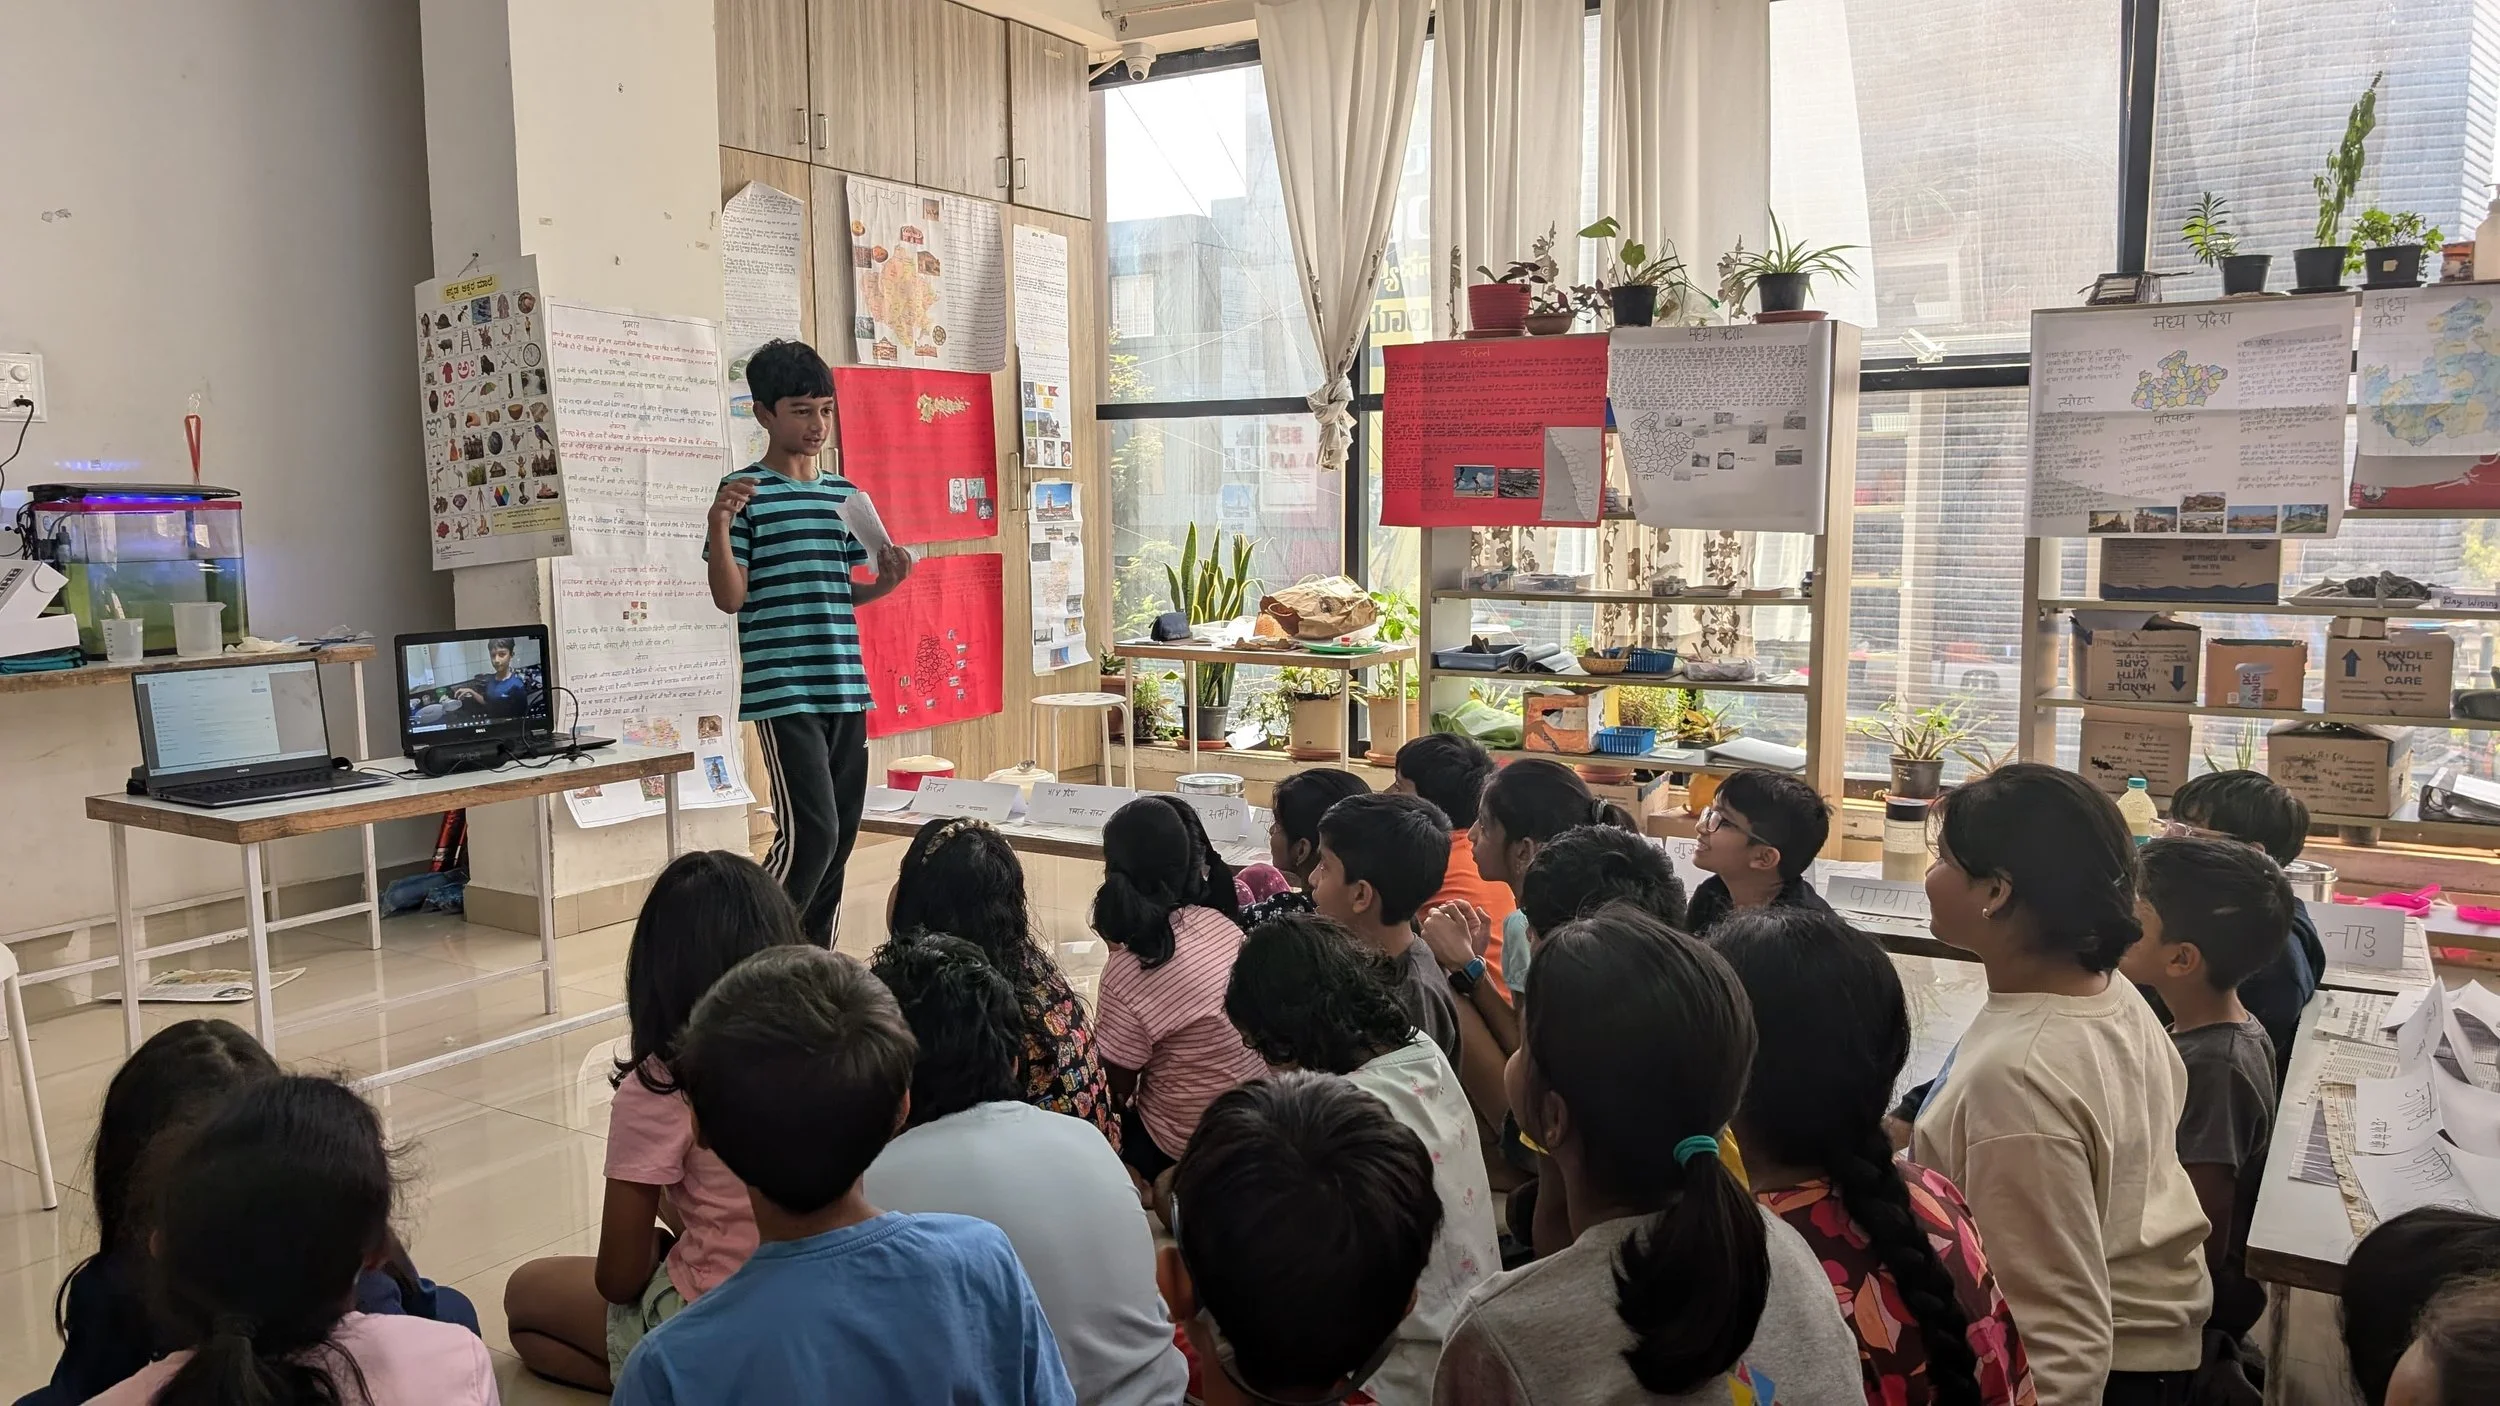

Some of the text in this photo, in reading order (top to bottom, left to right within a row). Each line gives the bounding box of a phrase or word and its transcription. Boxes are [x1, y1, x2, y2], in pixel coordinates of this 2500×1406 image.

[2153, 310, 2234, 329] मध्य प्रदेश
[2377, 650, 2433, 660] HANDLE
[2116, 659, 2149, 668] CARE
[2387, 663, 2421, 673] WITH
[2117, 671, 2147, 680] WITH
[2384, 676, 2422, 686] CARE
[2108, 682, 2156, 692] HANDLE
